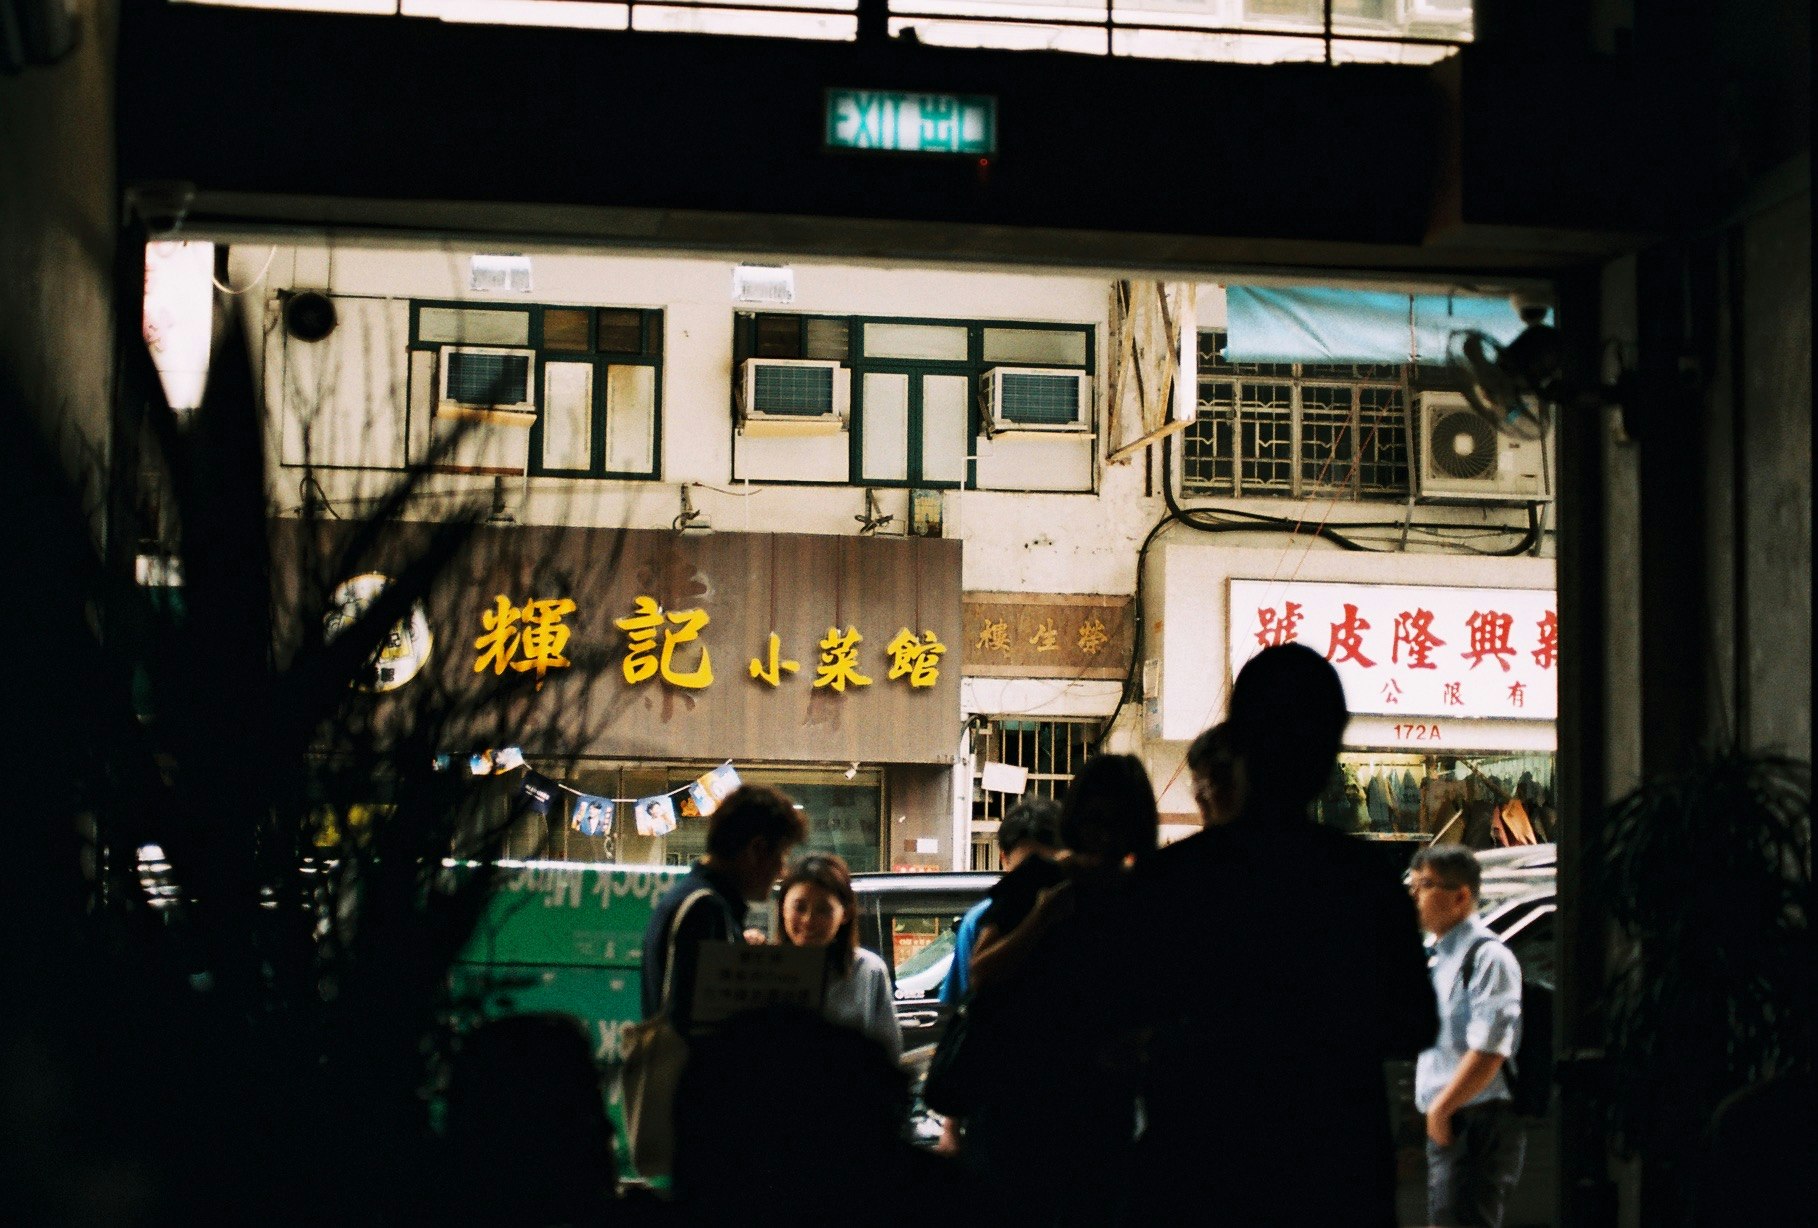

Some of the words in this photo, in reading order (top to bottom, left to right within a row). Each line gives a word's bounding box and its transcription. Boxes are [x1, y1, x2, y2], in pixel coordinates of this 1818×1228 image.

[830, 89, 907, 149] EXIT
[919, 93, 986, 152] 出口
[474, 594, 947, 692] 輝記小菜館
[1393, 724, 1442, 741] 172A
